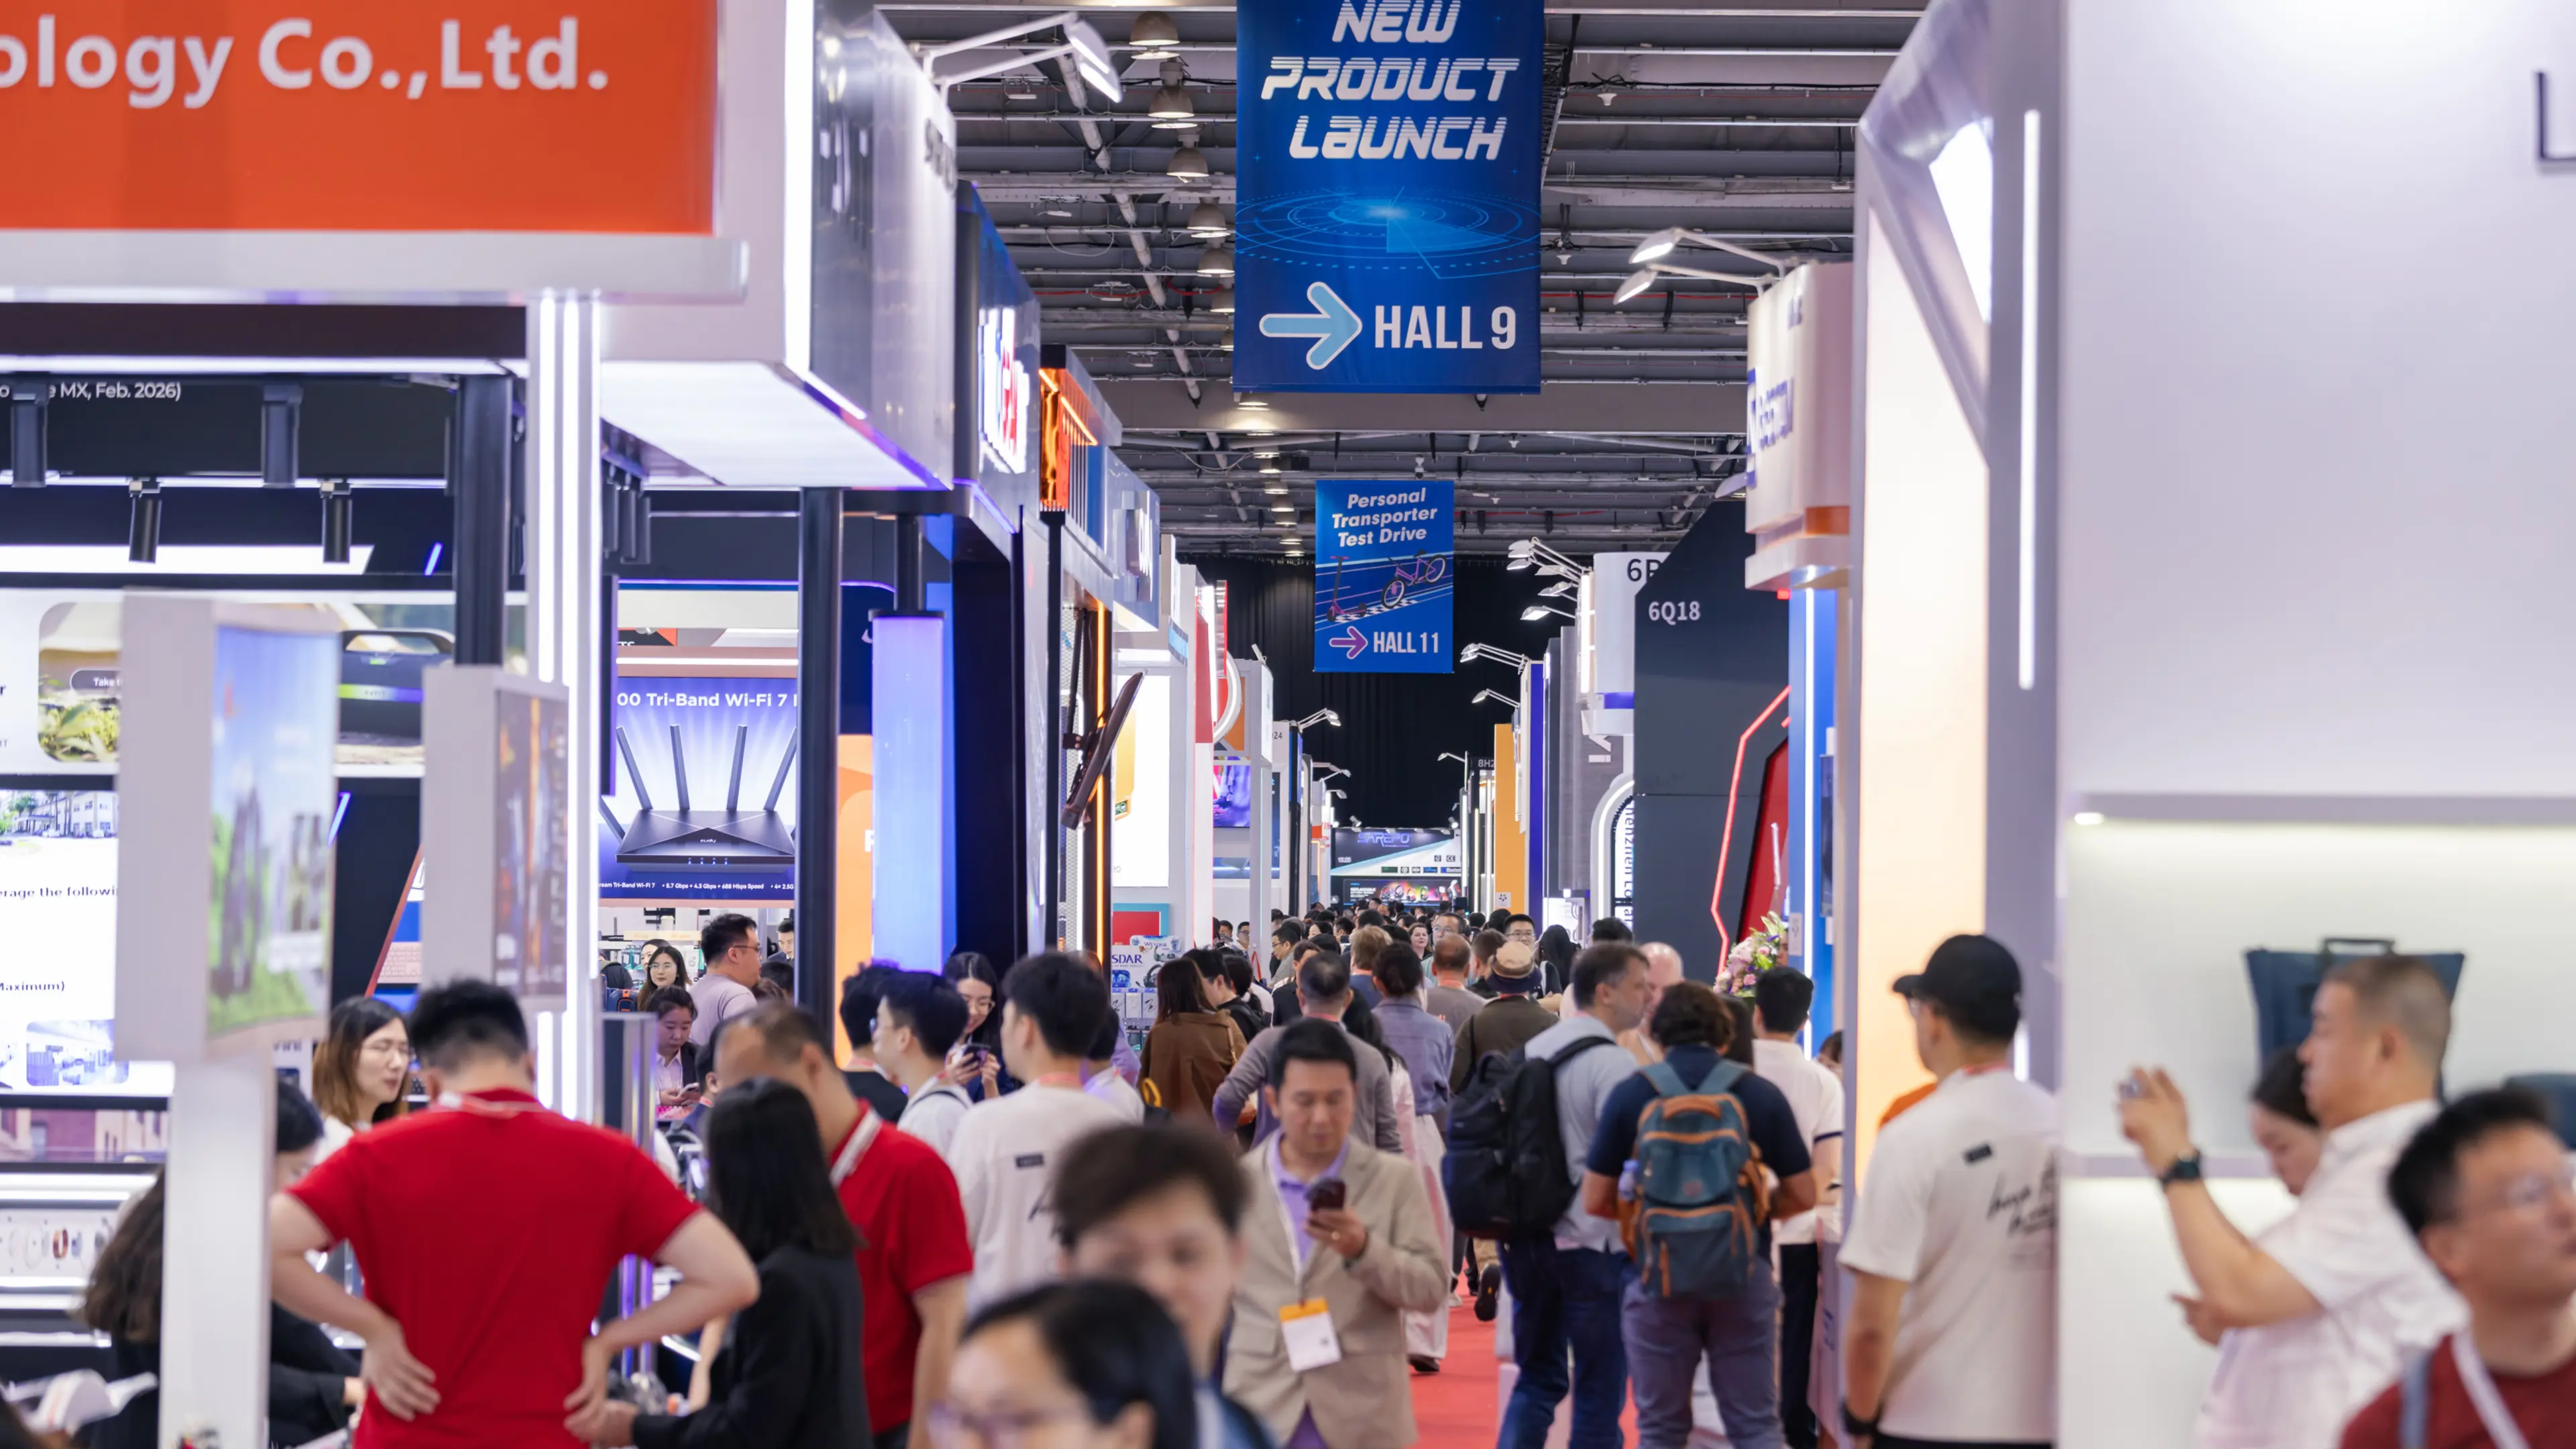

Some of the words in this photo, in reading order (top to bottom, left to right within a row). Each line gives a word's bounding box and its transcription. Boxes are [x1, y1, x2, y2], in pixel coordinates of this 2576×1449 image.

[1332, 0, 1460, 42] NEW
[258, 16, 609, 99] Co.,Ltd.
[1261, 56, 1520, 101] PRODUCT
[1375, 305, 1483, 349] HALL
[1491, 306, 1517, 350] 9
[60, 382, 92, 400] MX,
[96, 382, 131, 398] Feb.
[134, 382, 181, 401] 2026)
[1348, 488, 1426, 508] Personal
[1332, 508, 1438, 529] Transporter
[1338, 531, 1373, 547] Test
[1379, 527, 1428, 543] Drive
[1648, 601, 1701, 625] 6Q18
[1374, 632, 1416, 653] HALL
[1420, 632, 1438, 653] 11
[93, 677, 115, 687] Take
[647, 693, 719, 706] Tri-Band
[724, 694, 771, 707] Wi-Fi
[777, 694, 788, 707] 7
[40, 887, 62, 897] the
[1112, 954, 1143, 964] SDAR
